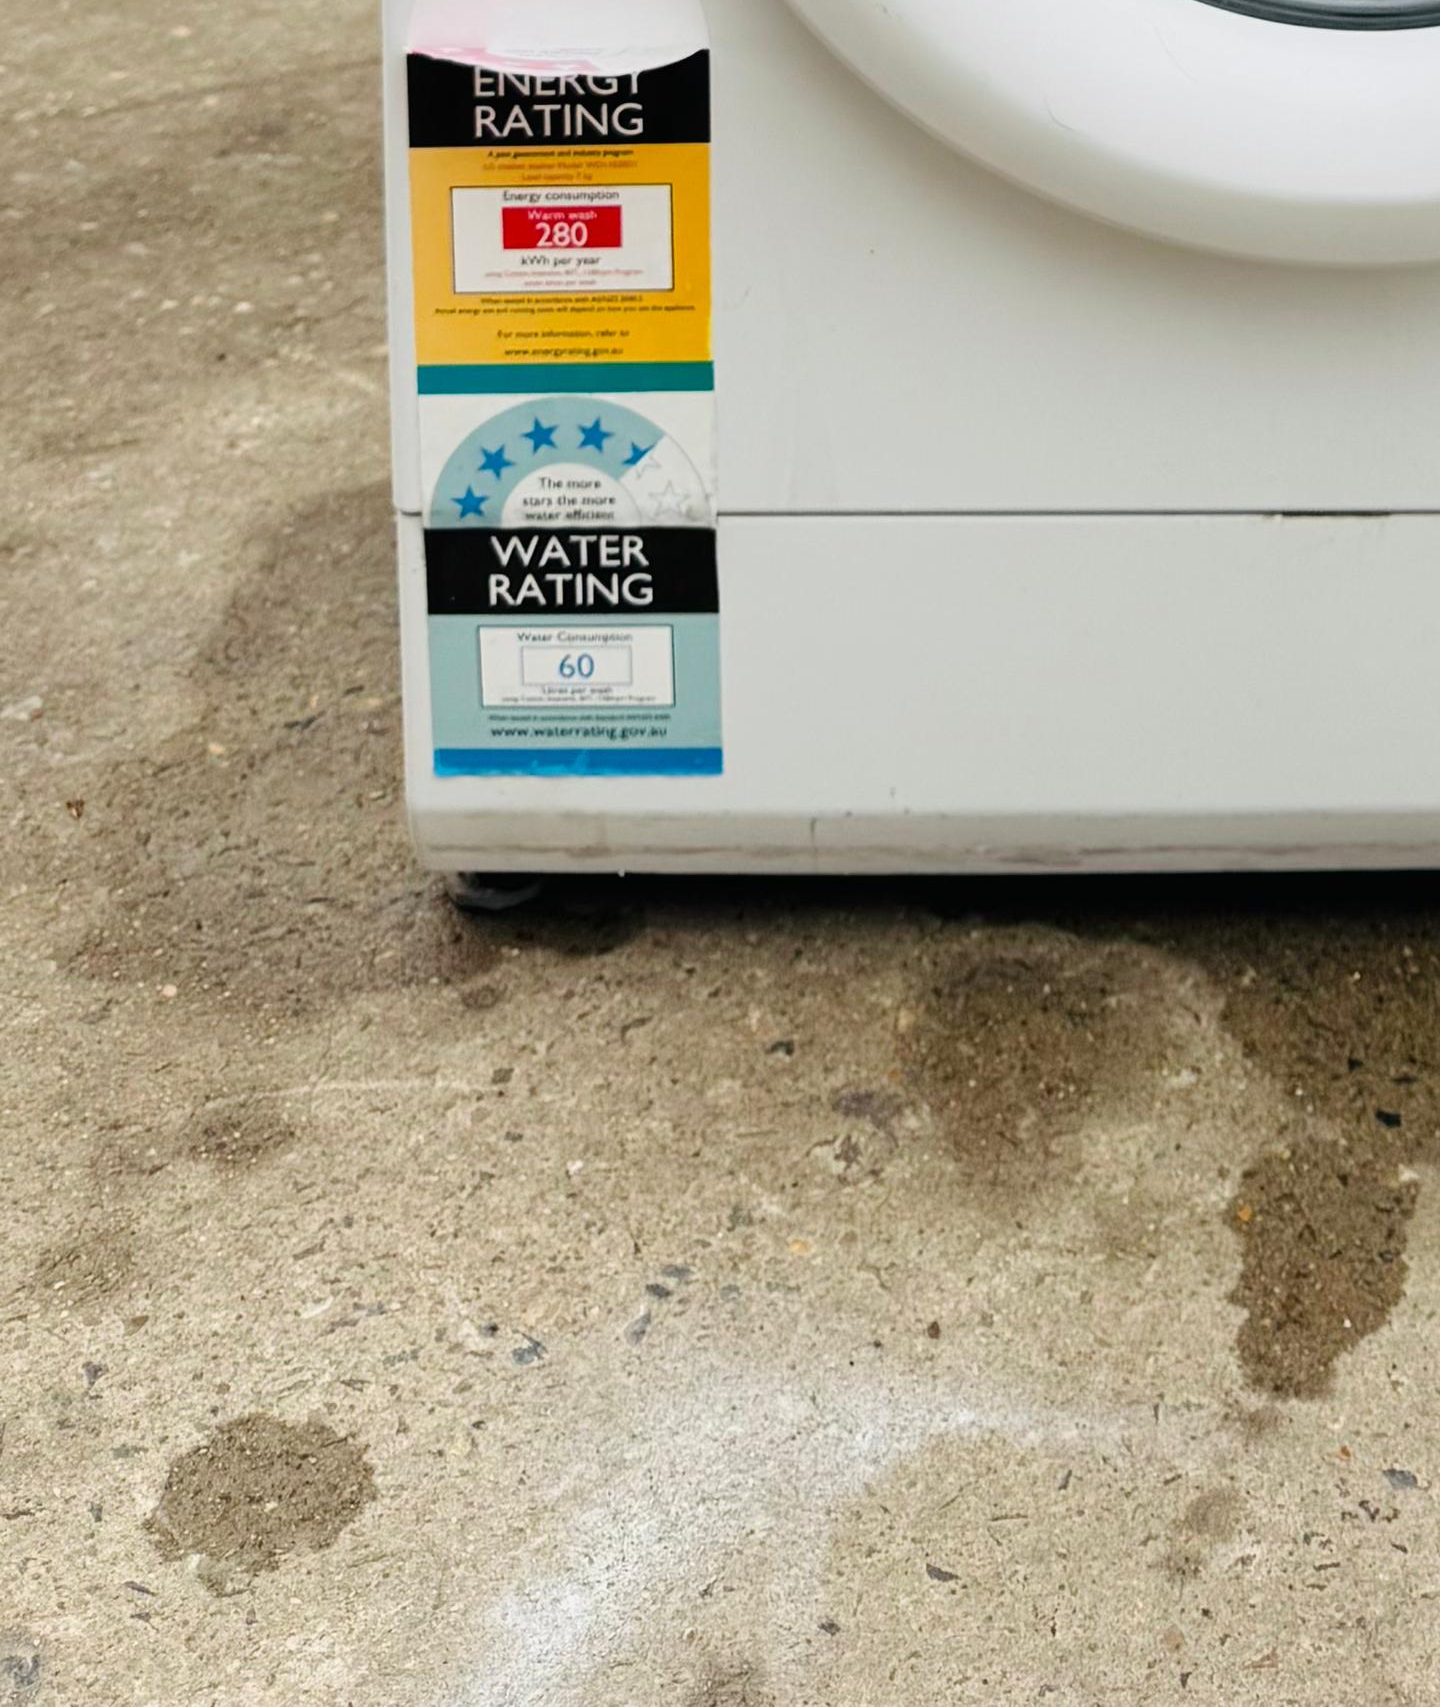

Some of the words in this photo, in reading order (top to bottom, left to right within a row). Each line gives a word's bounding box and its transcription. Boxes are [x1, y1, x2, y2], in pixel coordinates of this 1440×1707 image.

[474, 102, 645, 138] RATING
[503, 190, 541, 203] Energy
[545, 190, 620, 204] consumption
[528, 209, 565, 220] Warm
[535, 221, 588, 248] 280
[490, 534, 650, 568] WATER
[488, 573, 654, 608] RATING
[558, 653, 595, 679] 60
